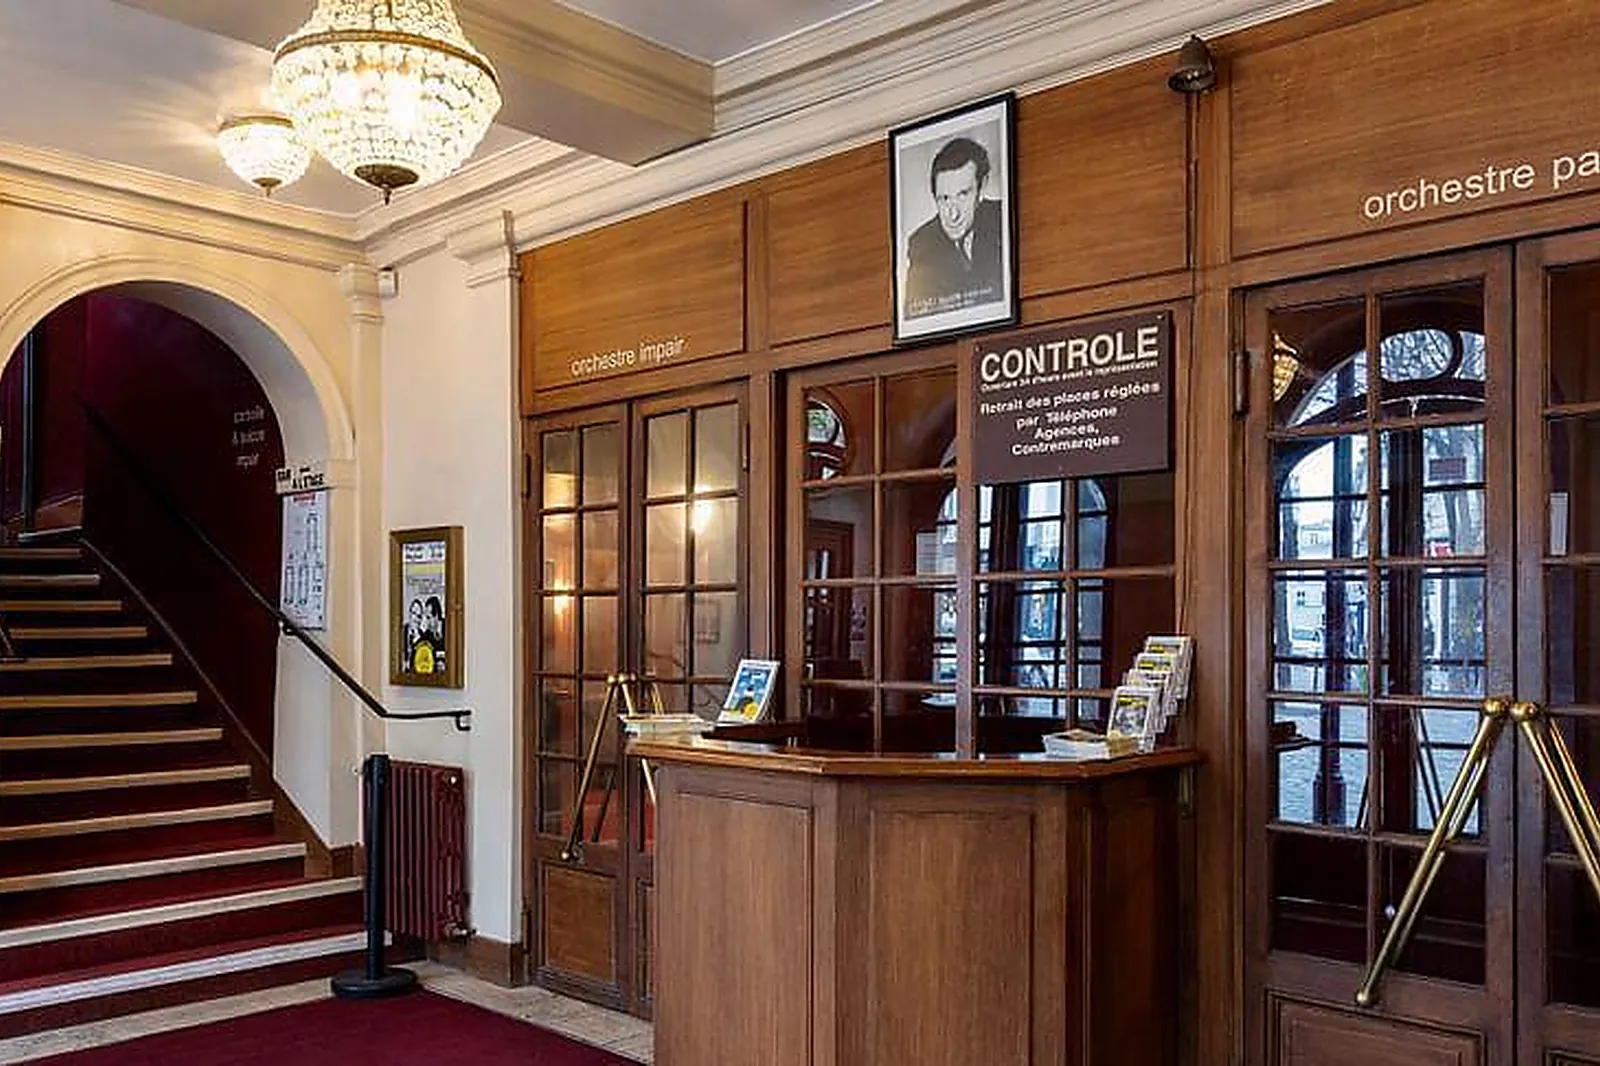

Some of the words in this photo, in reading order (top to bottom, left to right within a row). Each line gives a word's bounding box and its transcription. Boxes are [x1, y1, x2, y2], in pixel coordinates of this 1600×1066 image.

[1363, 162, 1536, 219] orchestre
[570, 349, 635, 376] orchestre
[640, 337, 685, 362] impair
[980, 326, 1159, 382] CONTROLE
[980, 399, 1023, 414] Retrait
[1025, 396, 1051, 409] des
[1053, 390, 1101, 408] places
[1103, 382, 1160, 400] réglées
[1016, 416, 1040, 431] par
[1011, 436, 1120, 455] Contremarques
